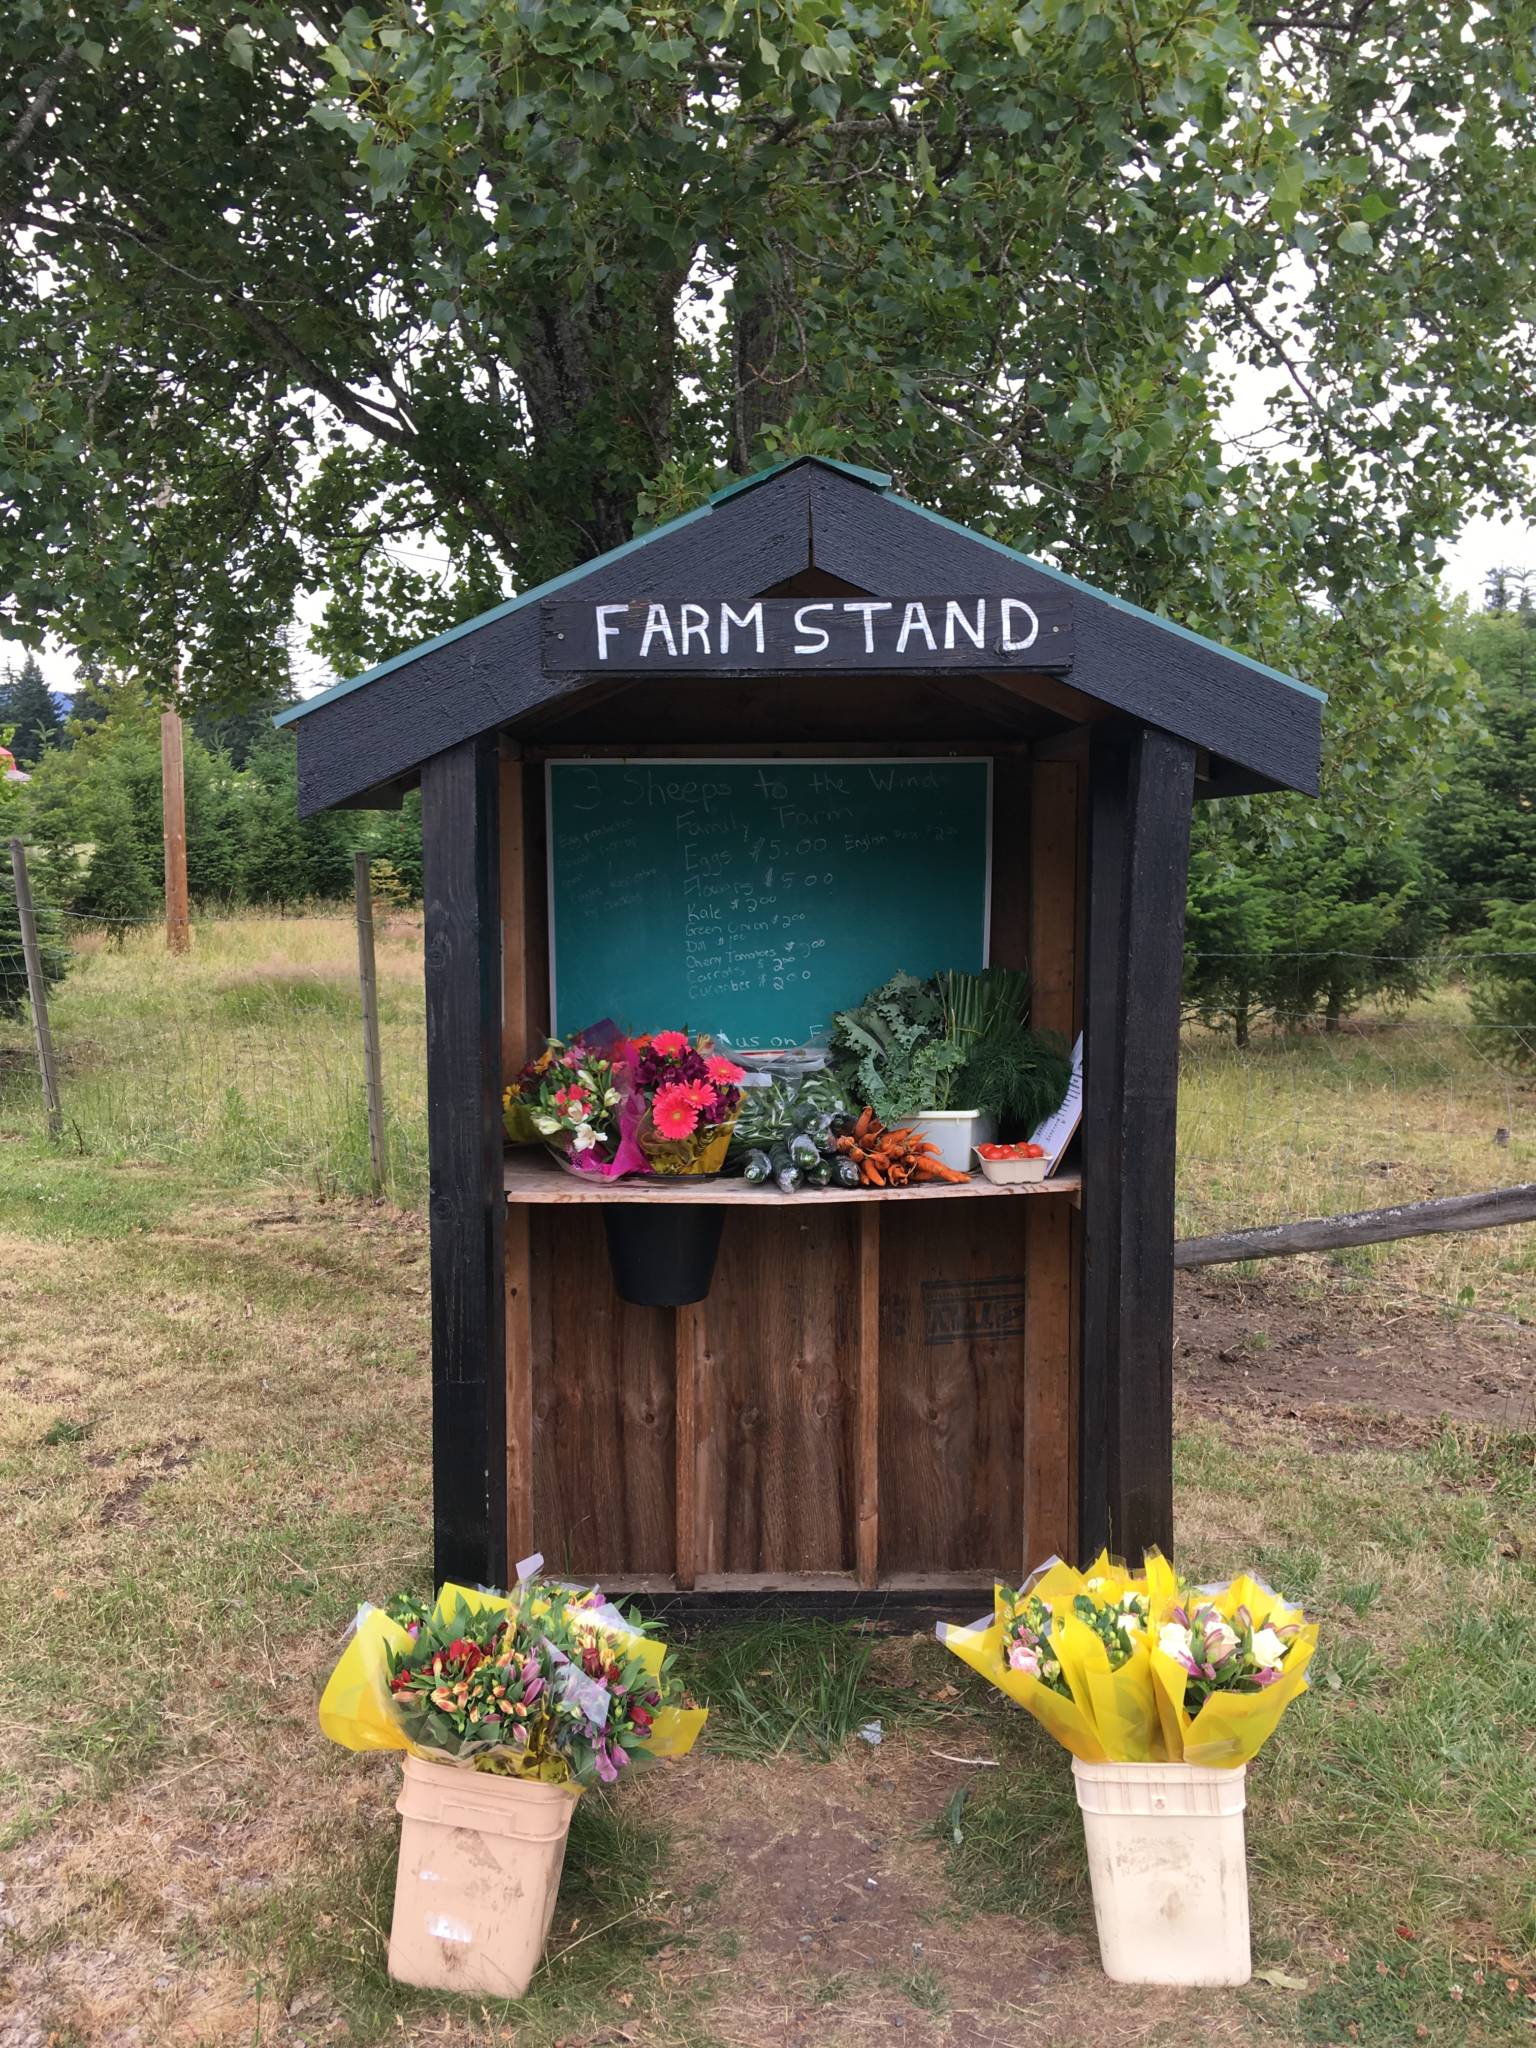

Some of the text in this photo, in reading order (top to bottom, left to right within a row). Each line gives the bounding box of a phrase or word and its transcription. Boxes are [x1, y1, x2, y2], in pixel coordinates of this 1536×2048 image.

[595, 597, 1040, 661] FARM STAND
[808, 770, 851, 796] the
[676, 802, 855, 843] Family Farm
[684, 843, 733, 877] Eggs
[687, 903, 724, 923] Kale
[685, 939, 708, 954] Dill
[736, 1036, 761, 1048] us
[770, 1036, 798, 1047] on
